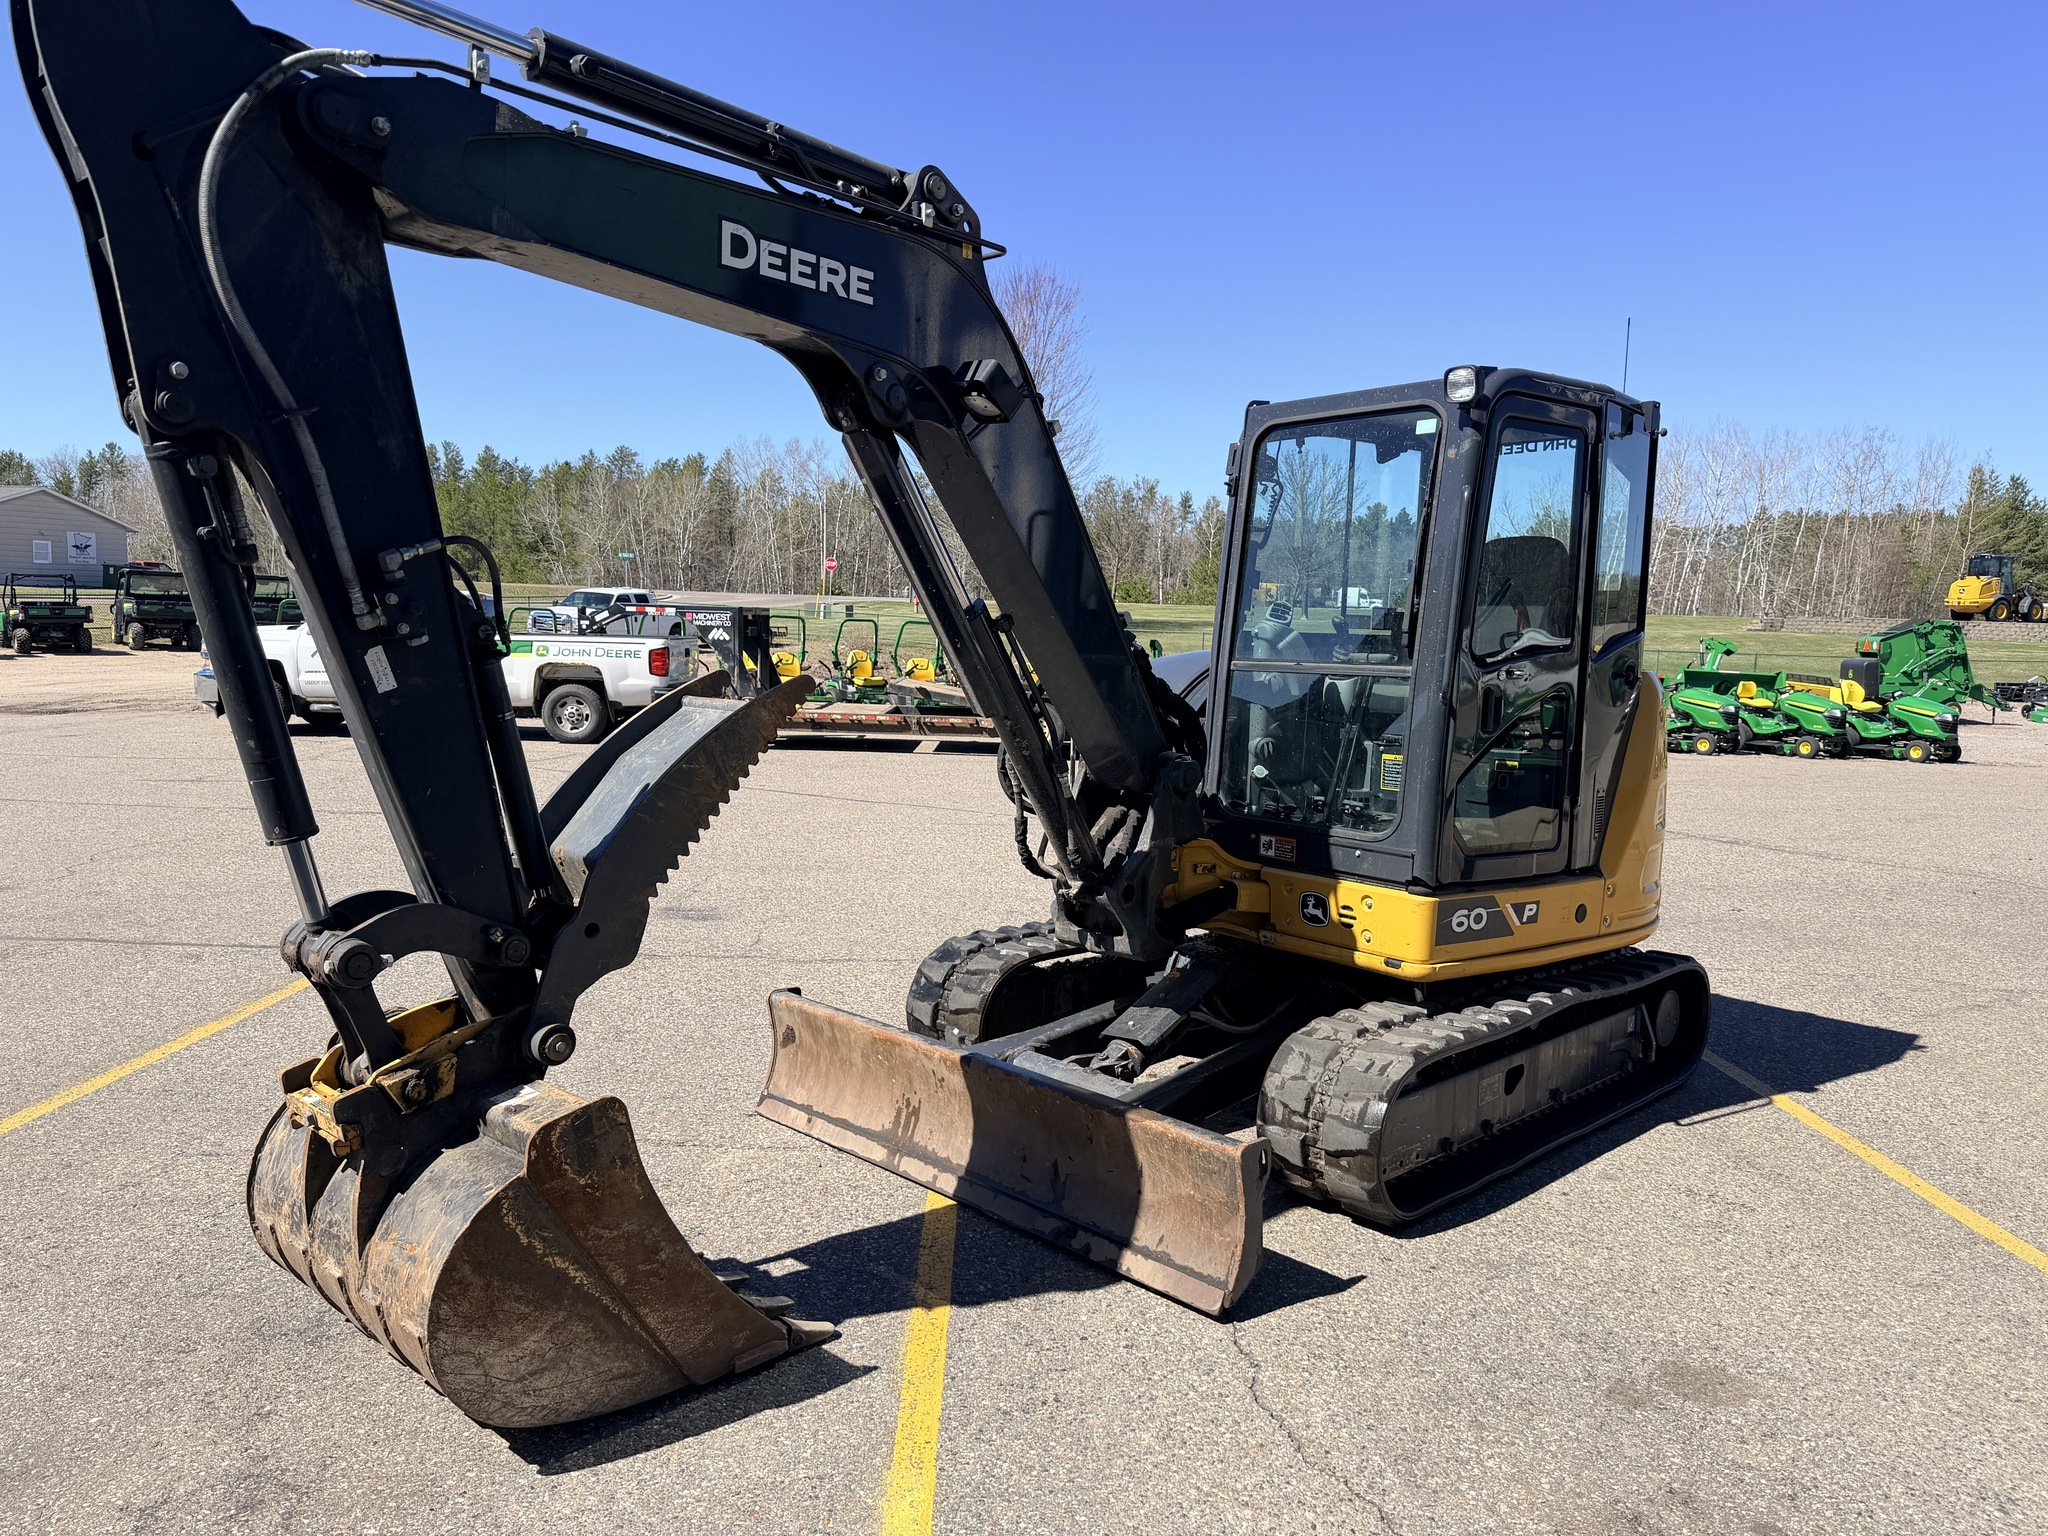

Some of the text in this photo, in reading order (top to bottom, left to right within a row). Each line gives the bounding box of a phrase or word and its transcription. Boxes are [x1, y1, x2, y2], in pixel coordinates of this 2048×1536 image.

[721, 219, 874, 306] DEERE
[693, 612, 731, 621] MIDWEST
[553, 646, 642, 659] JOHN DEERE
[1451, 903, 1538, 933] 60 P
